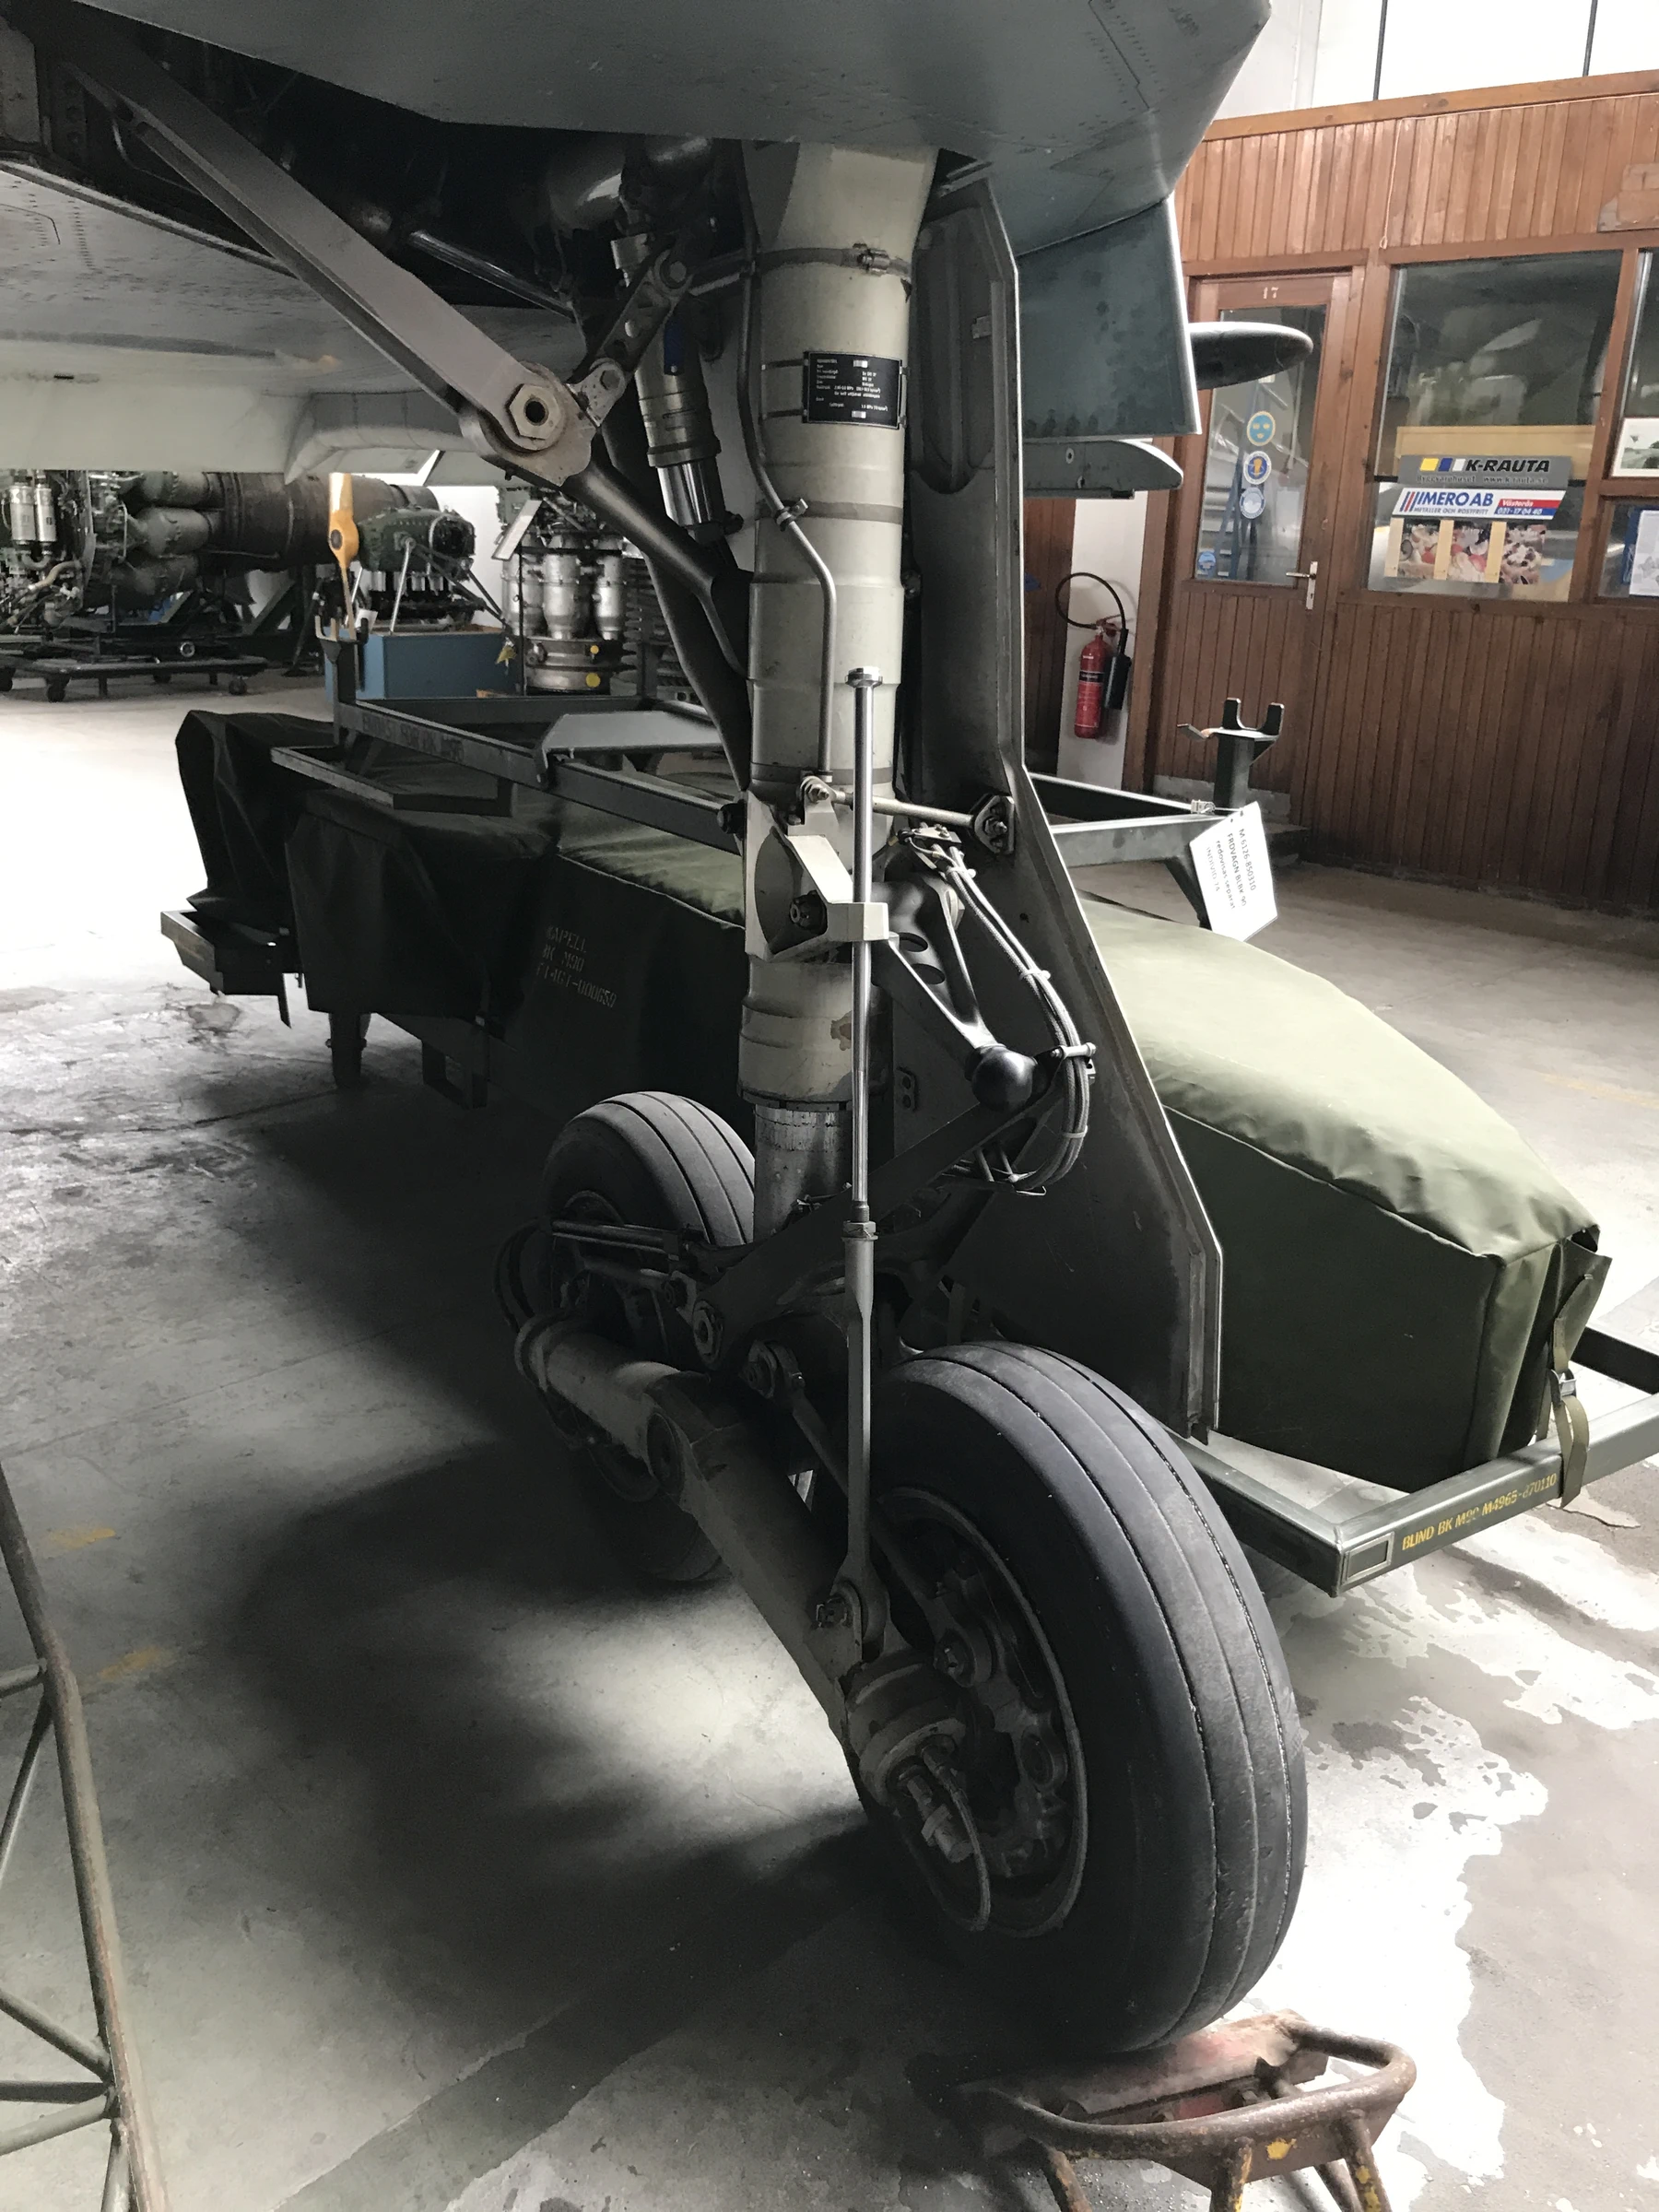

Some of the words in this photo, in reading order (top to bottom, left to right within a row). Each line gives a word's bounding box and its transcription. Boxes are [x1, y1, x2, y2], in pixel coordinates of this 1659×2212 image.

[1465, 459, 1550, 473] K-RAUTA
[1418, 491, 1470, 506] IMERO
[1469, 492, 1494, 507] AB
[1239, 828, 1246, 839] M
[1227, 832, 1240, 874] FRDVAGN
[1402, 1525, 1435, 1551] BLIND
[1437, 1518, 1453, 1536] BK
